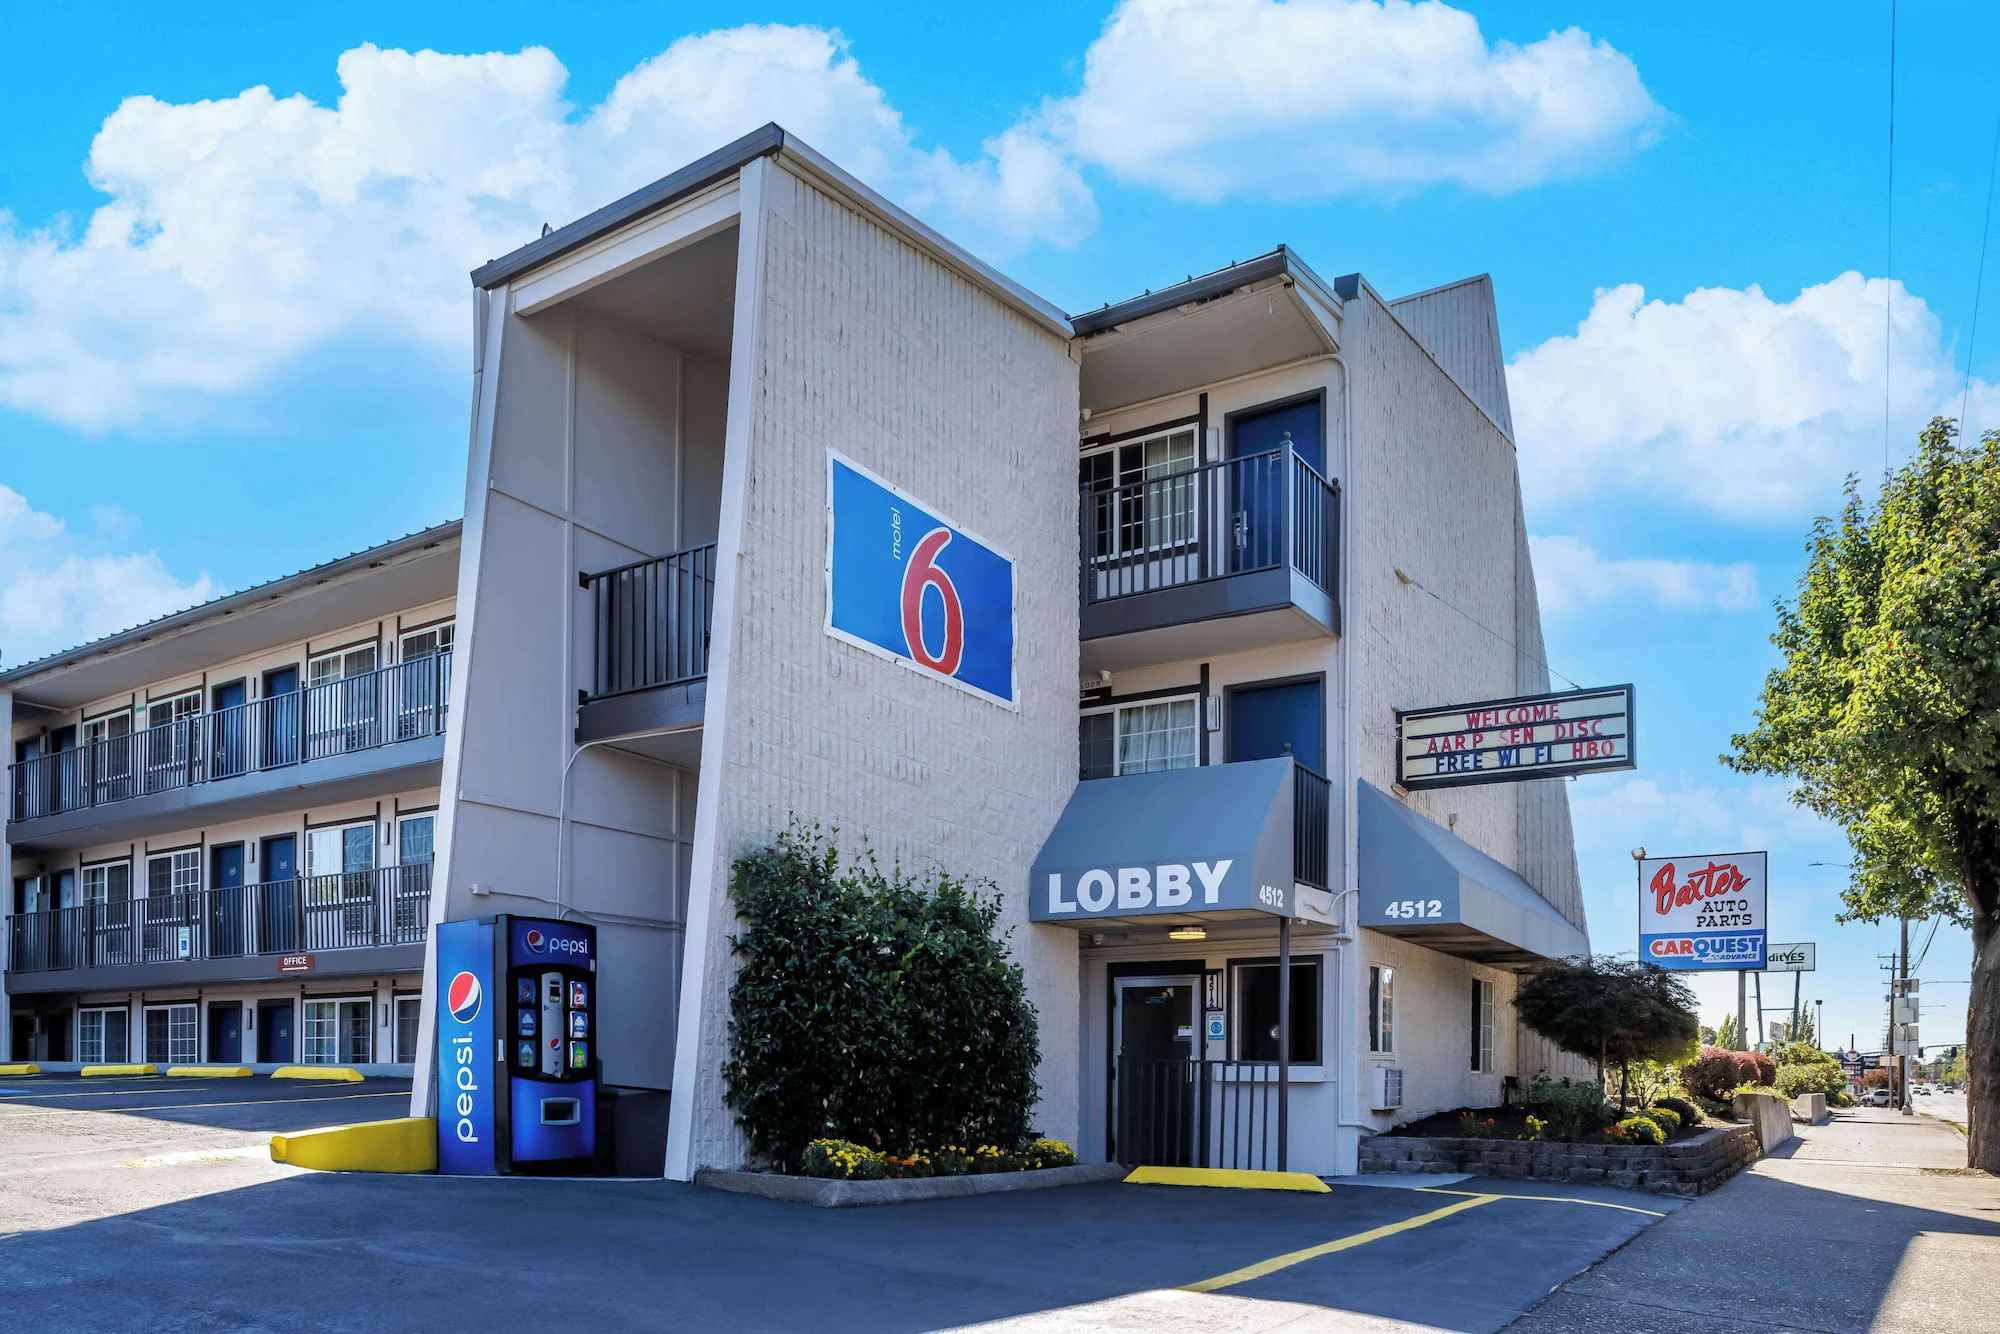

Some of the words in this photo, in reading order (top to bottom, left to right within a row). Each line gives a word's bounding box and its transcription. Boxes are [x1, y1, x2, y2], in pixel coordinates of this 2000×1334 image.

[890, 507, 902, 560] motel
[900, 526, 964, 677] 6
[1465, 703, 1560, 729] WELCOME
[1427, 732, 1484, 754] AARP
[1499, 727, 1534, 745] SEN
[1555, 719, 1603, 740] DISC
[1436, 753, 1482, 774] FREE
[1572, 739, 1615, 760] HBO
[1048, 859, 1234, 914] LOBBY
[1259, 884, 1284, 908] 4512
[1650, 861, 1752, 916] Baxter
[1385, 899, 1442, 919] 4512
[1701, 899, 1748, 913] AUTO
[1696, 913, 1752, 928] PARTS
[549, 938, 588, 956] pepsi
[1651, 938, 1761, 958] CARQUEST
[283, 956, 307, 966] OFFICE
[452, 1037, 479, 1143] pepsi
